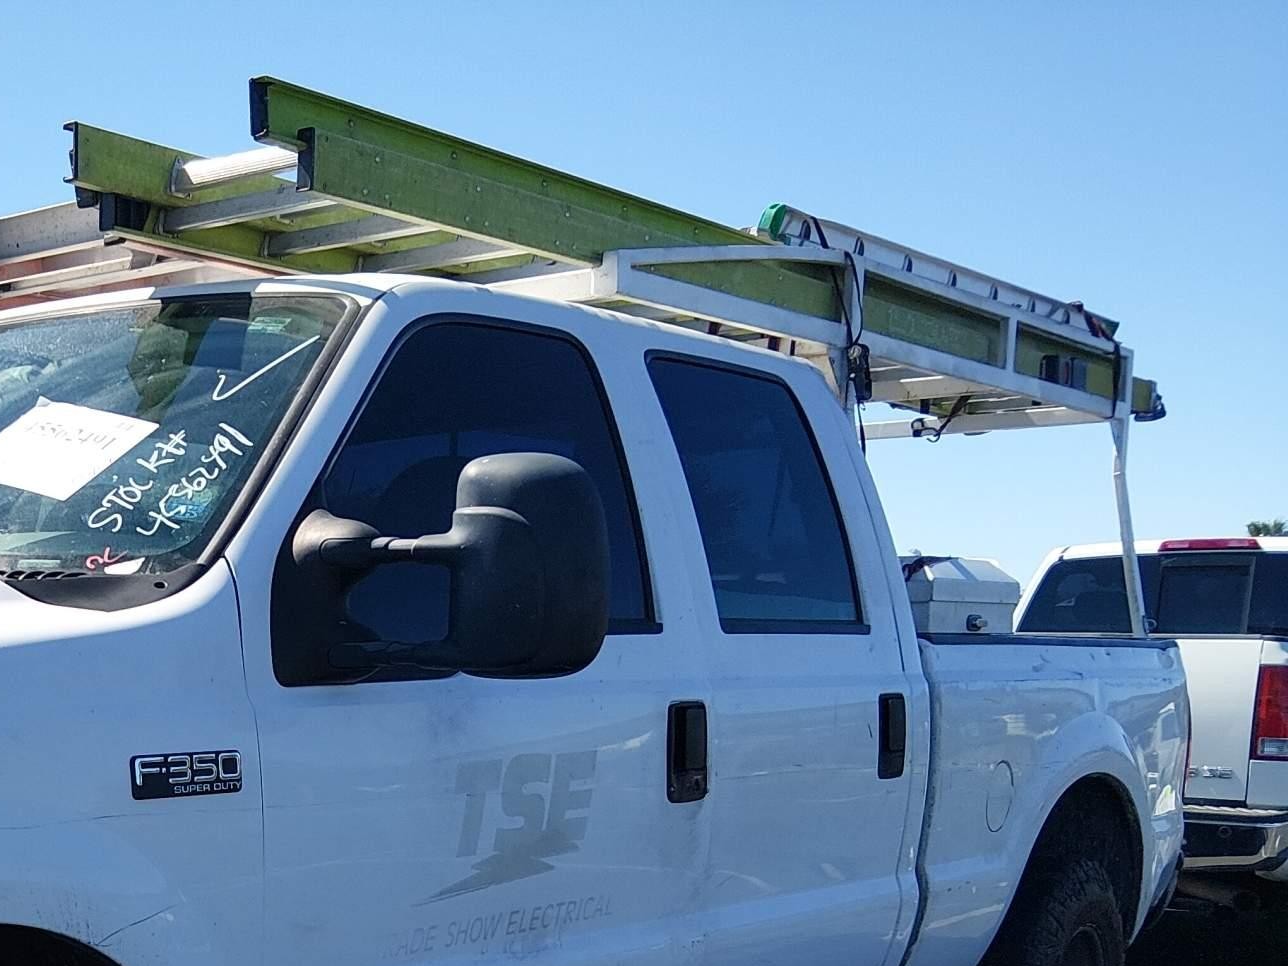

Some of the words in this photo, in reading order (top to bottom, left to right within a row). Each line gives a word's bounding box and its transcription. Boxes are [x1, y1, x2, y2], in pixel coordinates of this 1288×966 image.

[174, 783, 211, 794] SUPER
[213, 781, 242, 791] DUTY
[455, 750, 598, 858] TSE
[445, 912, 503, 949] SHOW
[505, 896, 614, 936] ELECTRICAL
